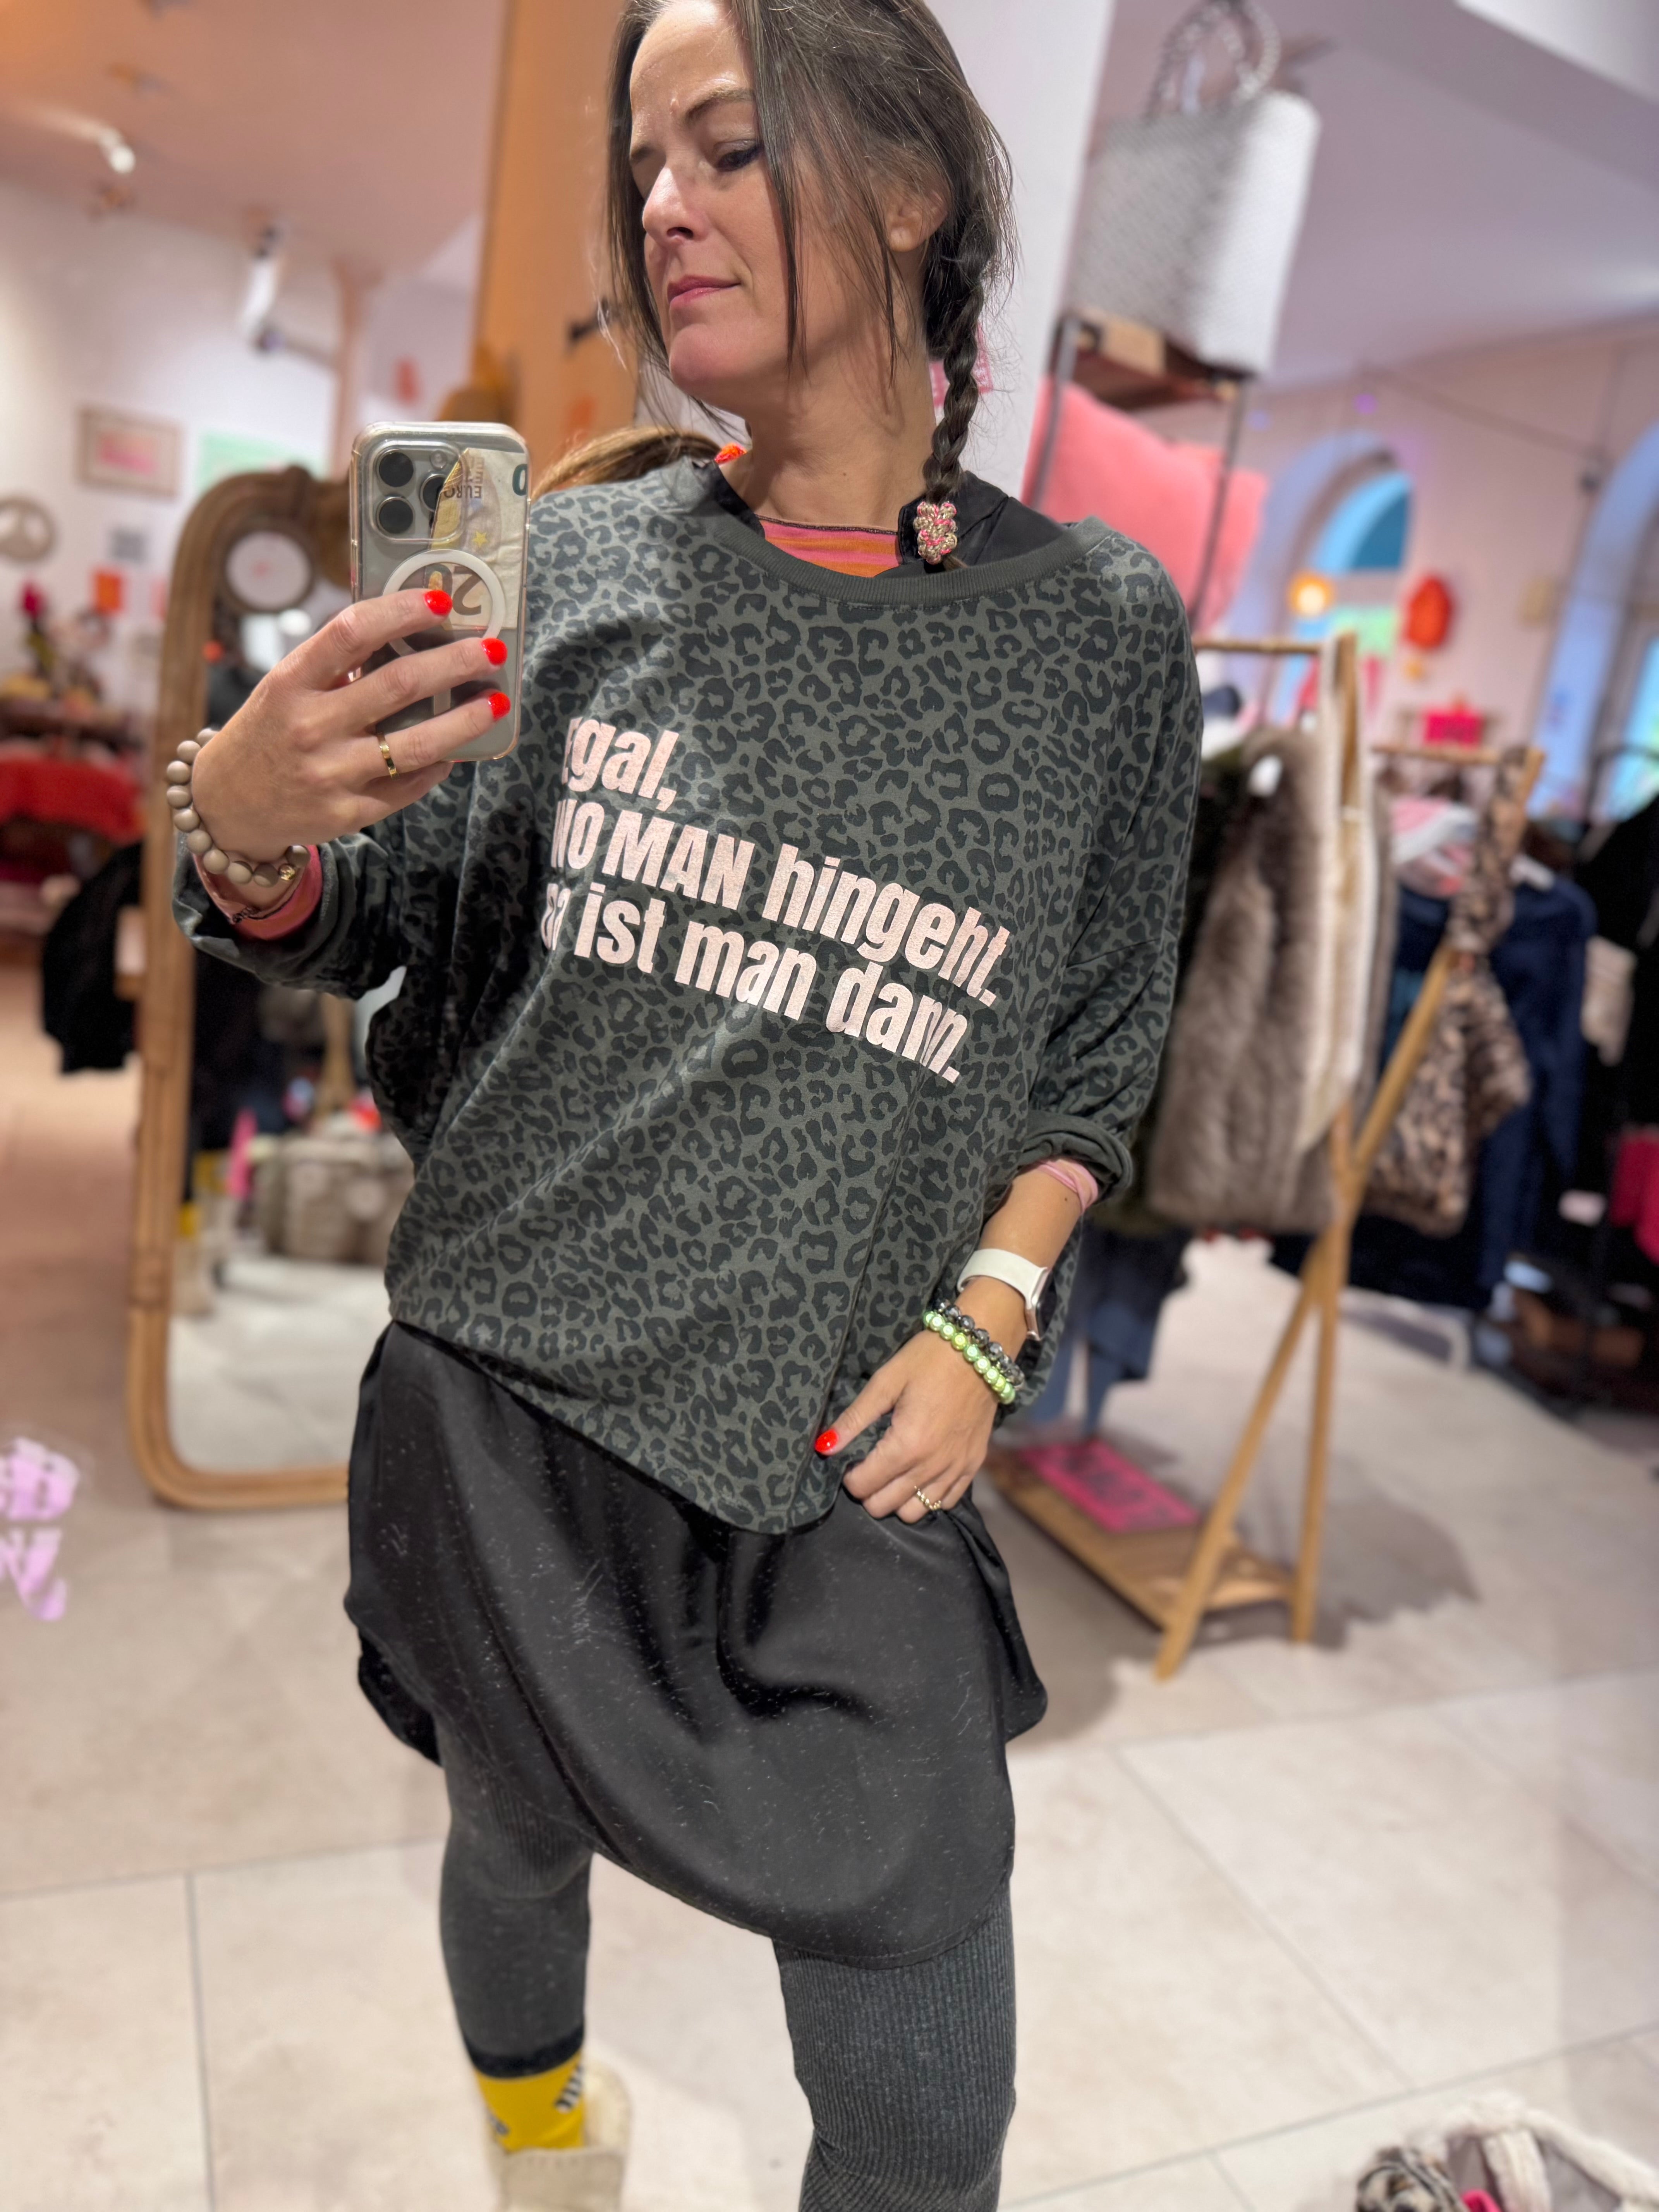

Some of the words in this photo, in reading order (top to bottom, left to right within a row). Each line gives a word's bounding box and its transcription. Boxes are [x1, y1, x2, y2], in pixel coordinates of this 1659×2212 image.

[443, 485, 482, 498] EURO
[603, 809, 755, 910] MAN
[574, 882, 665, 973] ist
[675, 921, 817, 1020] man
[826, 962, 968, 1084] dann.
